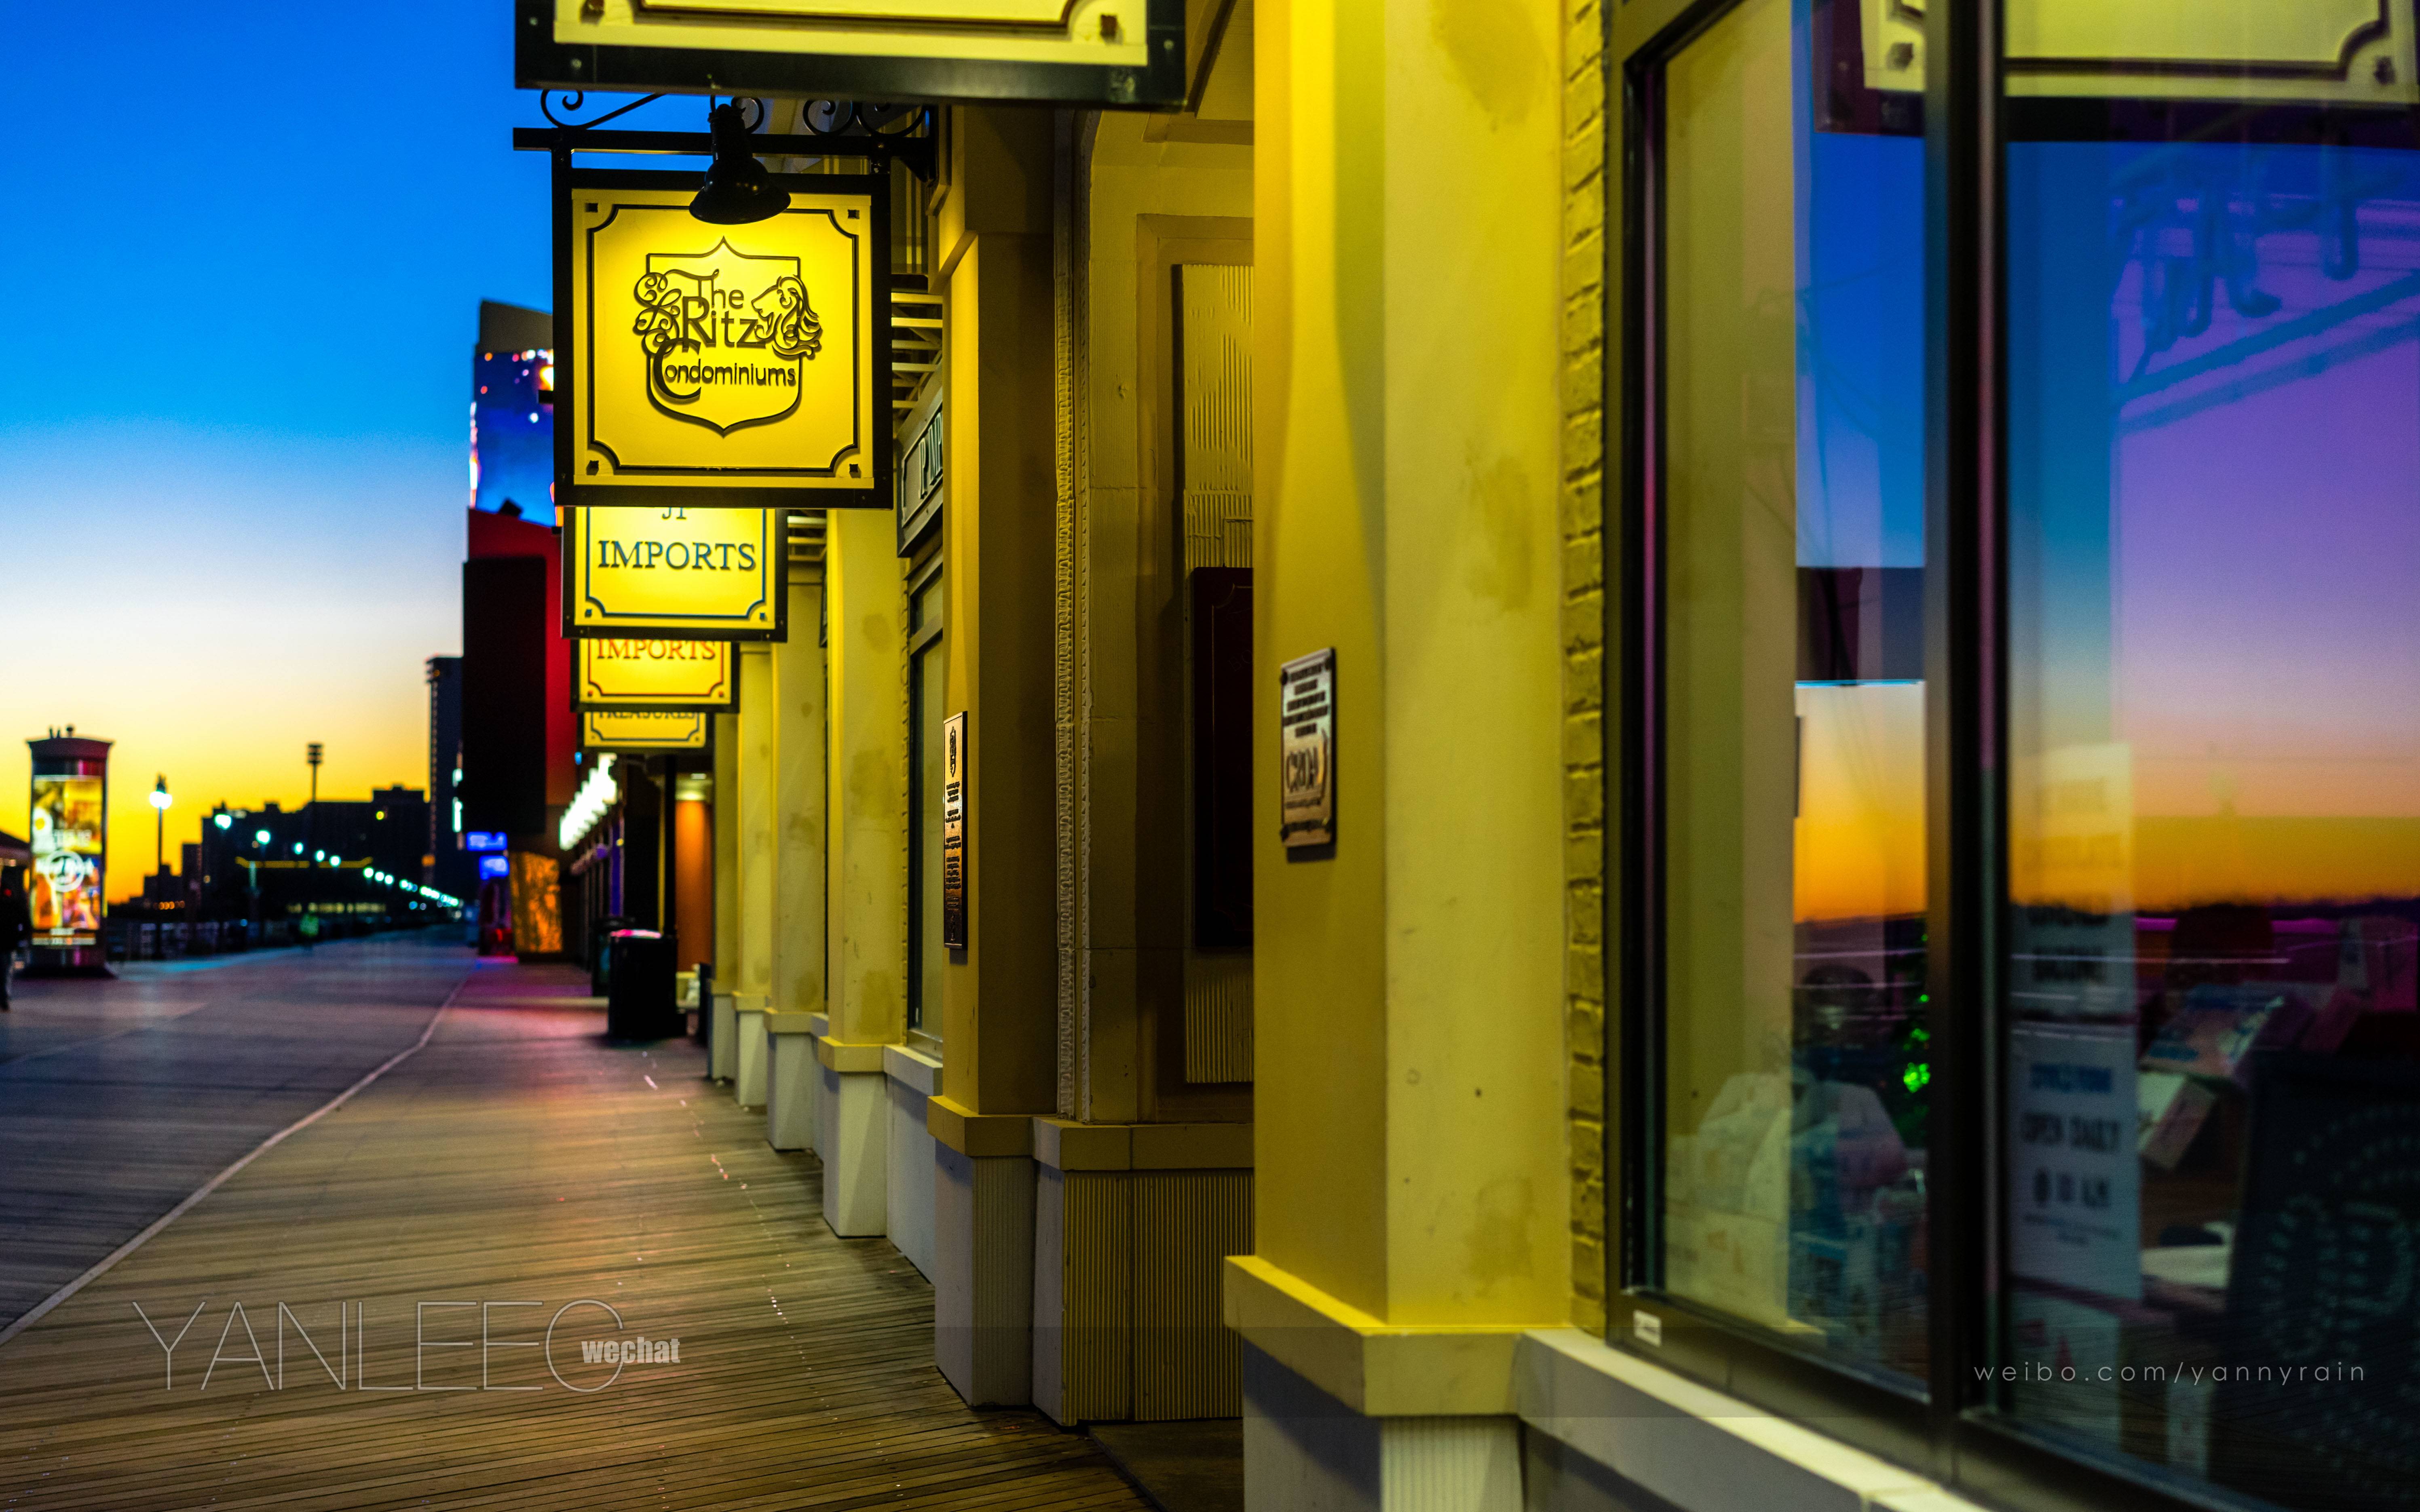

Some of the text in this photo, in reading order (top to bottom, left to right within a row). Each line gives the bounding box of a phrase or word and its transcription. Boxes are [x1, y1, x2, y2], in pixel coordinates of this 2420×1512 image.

[663, 268, 744, 309] The
[682, 296, 766, 352] Ritz
[653, 337, 796, 404] Condominiums
[598, 540, 756, 571] IMPORTS
